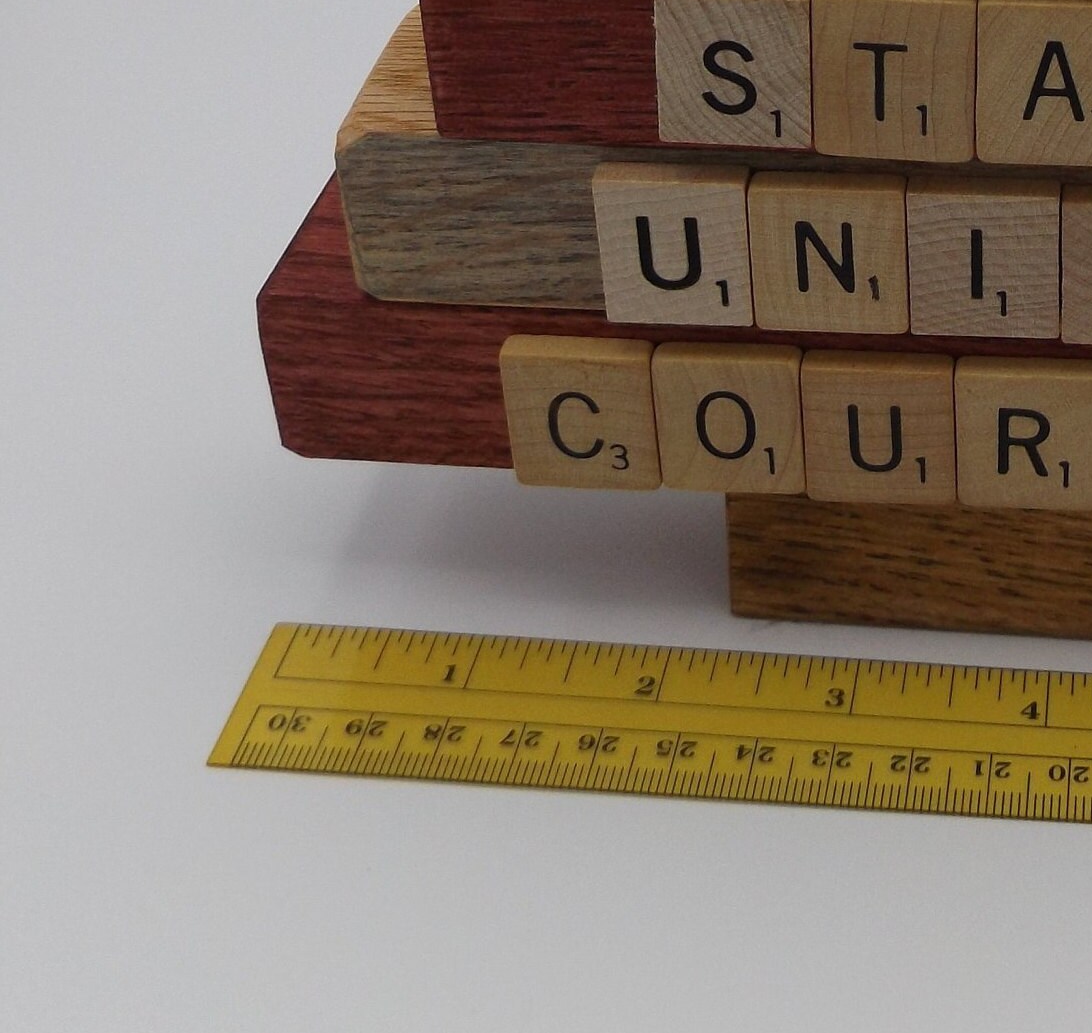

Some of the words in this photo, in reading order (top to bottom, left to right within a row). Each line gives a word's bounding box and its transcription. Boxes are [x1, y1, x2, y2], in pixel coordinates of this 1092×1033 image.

[442, 664, 457, 682] 1
[635, 676, 656, 695] 2
[825, 688, 845, 707] 3
[1021, 700, 1040, 720] 4
[268, 714, 307, 732] 30
[345, 720, 387, 737] 29
[424, 724, 466, 742] 28
[500, 728, 542, 746] 27
[578, 734, 620, 751] 26
[656, 739, 698, 757] 25
[736, 745, 776, 762] 24
[811, 749, 852, 767] 23
[890, 754, 931, 773] 22
[974, 759, 1011, 779] 21
[1048, 764, 1090, 782] 20
